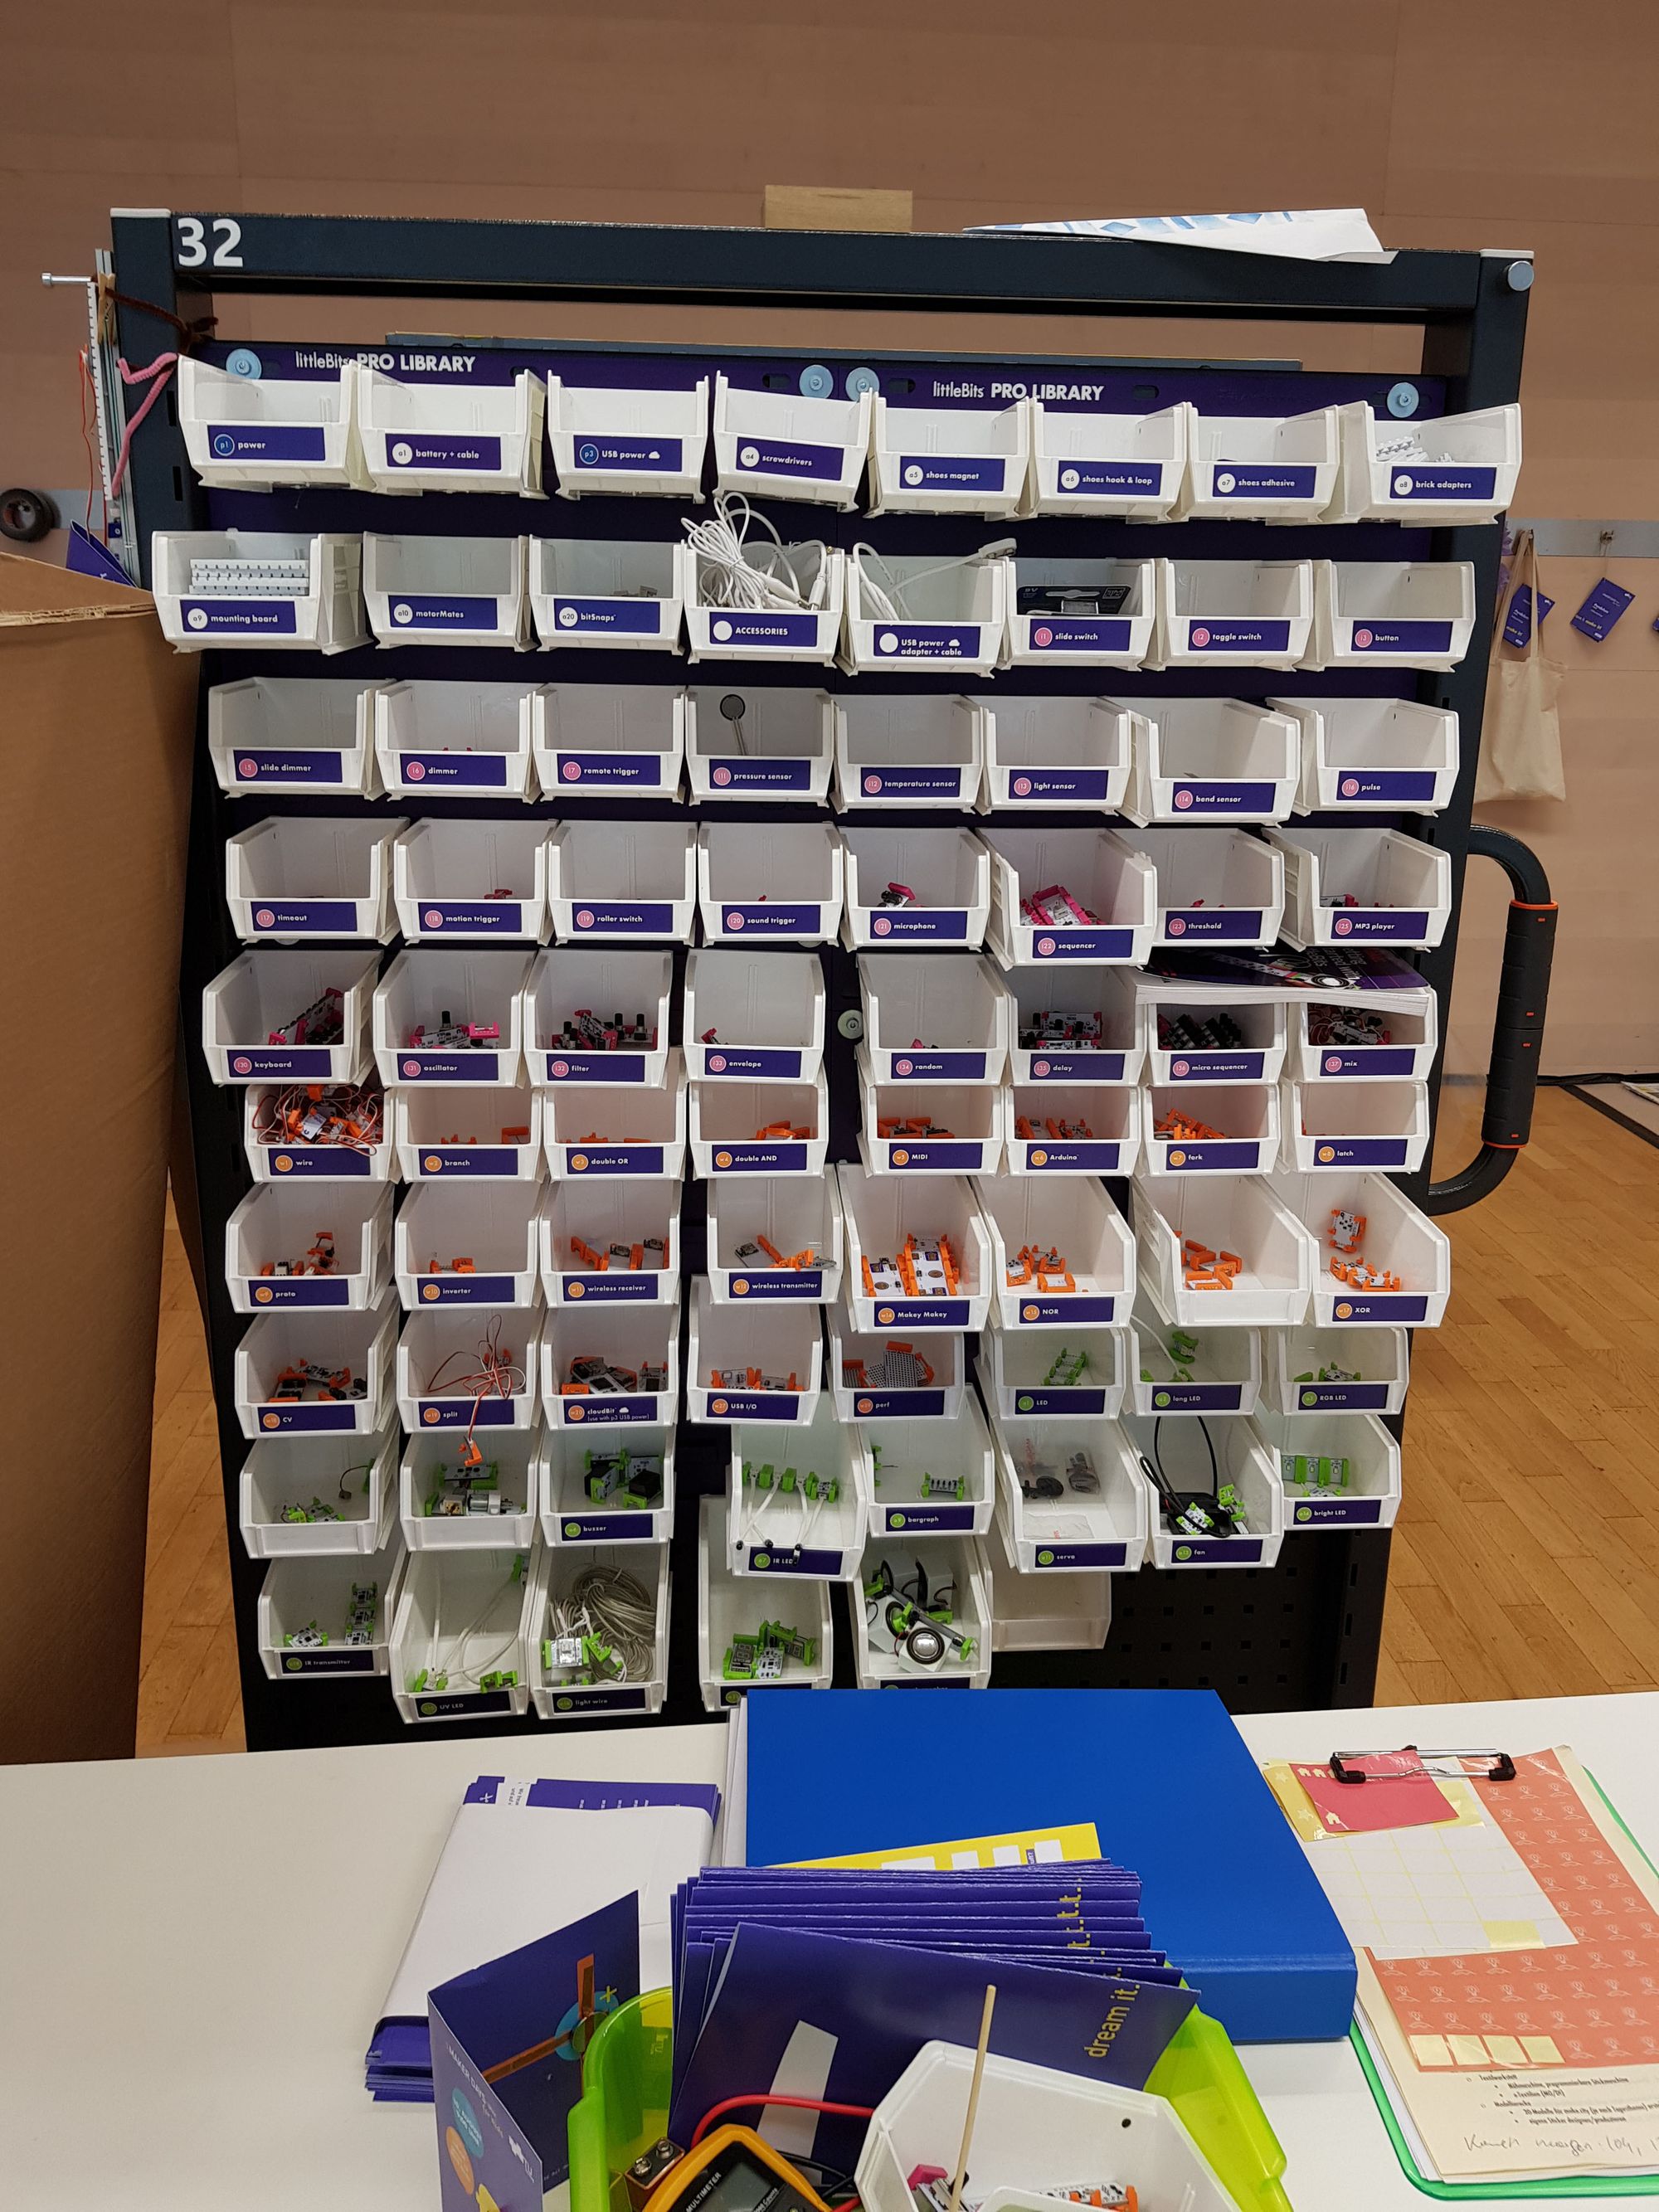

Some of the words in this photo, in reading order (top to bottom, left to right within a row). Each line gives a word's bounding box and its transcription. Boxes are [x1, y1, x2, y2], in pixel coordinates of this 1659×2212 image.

[178, 217, 243, 267] 32
[295, 351, 350, 369] littleBits
[356, 352, 395, 371] PRO
[400, 354, 475, 372] LIBRARY
[933, 381, 985, 399] littleBits
[990, 382, 1028, 400] PRO
[1032, 383, 1104, 401] LIBRARY
[238, 442, 265, 450] power
[416, 449, 447, 459] battery
[457, 450, 479, 459] cable
[762, 456, 812, 466] screwdrivers
[1135, 476, 1152, 485] loop
[1437, 481, 1472, 490] adapters
[211, 615, 251, 624] mounting
[581, 613, 615, 623] bitSnaps
[736, 627, 788, 635] ACCESSORIES
[1213, 633, 1237, 641] toggle
[901, 648, 932, 656] adapter
[613, 767, 639, 776] trigger
[1034, 782, 1050, 790] light
[1361, 784, 1380, 792] pulse
[893, 922, 936, 931] microphone
[255, 1061, 292, 1069] keyboard
[443, 1411, 458, 1419] split
[1084, 2006, 1130, 2058] dream
[1110, 1984, 1141, 2001] it.
[686, 2172, 722, 2212] MULTIMETER
